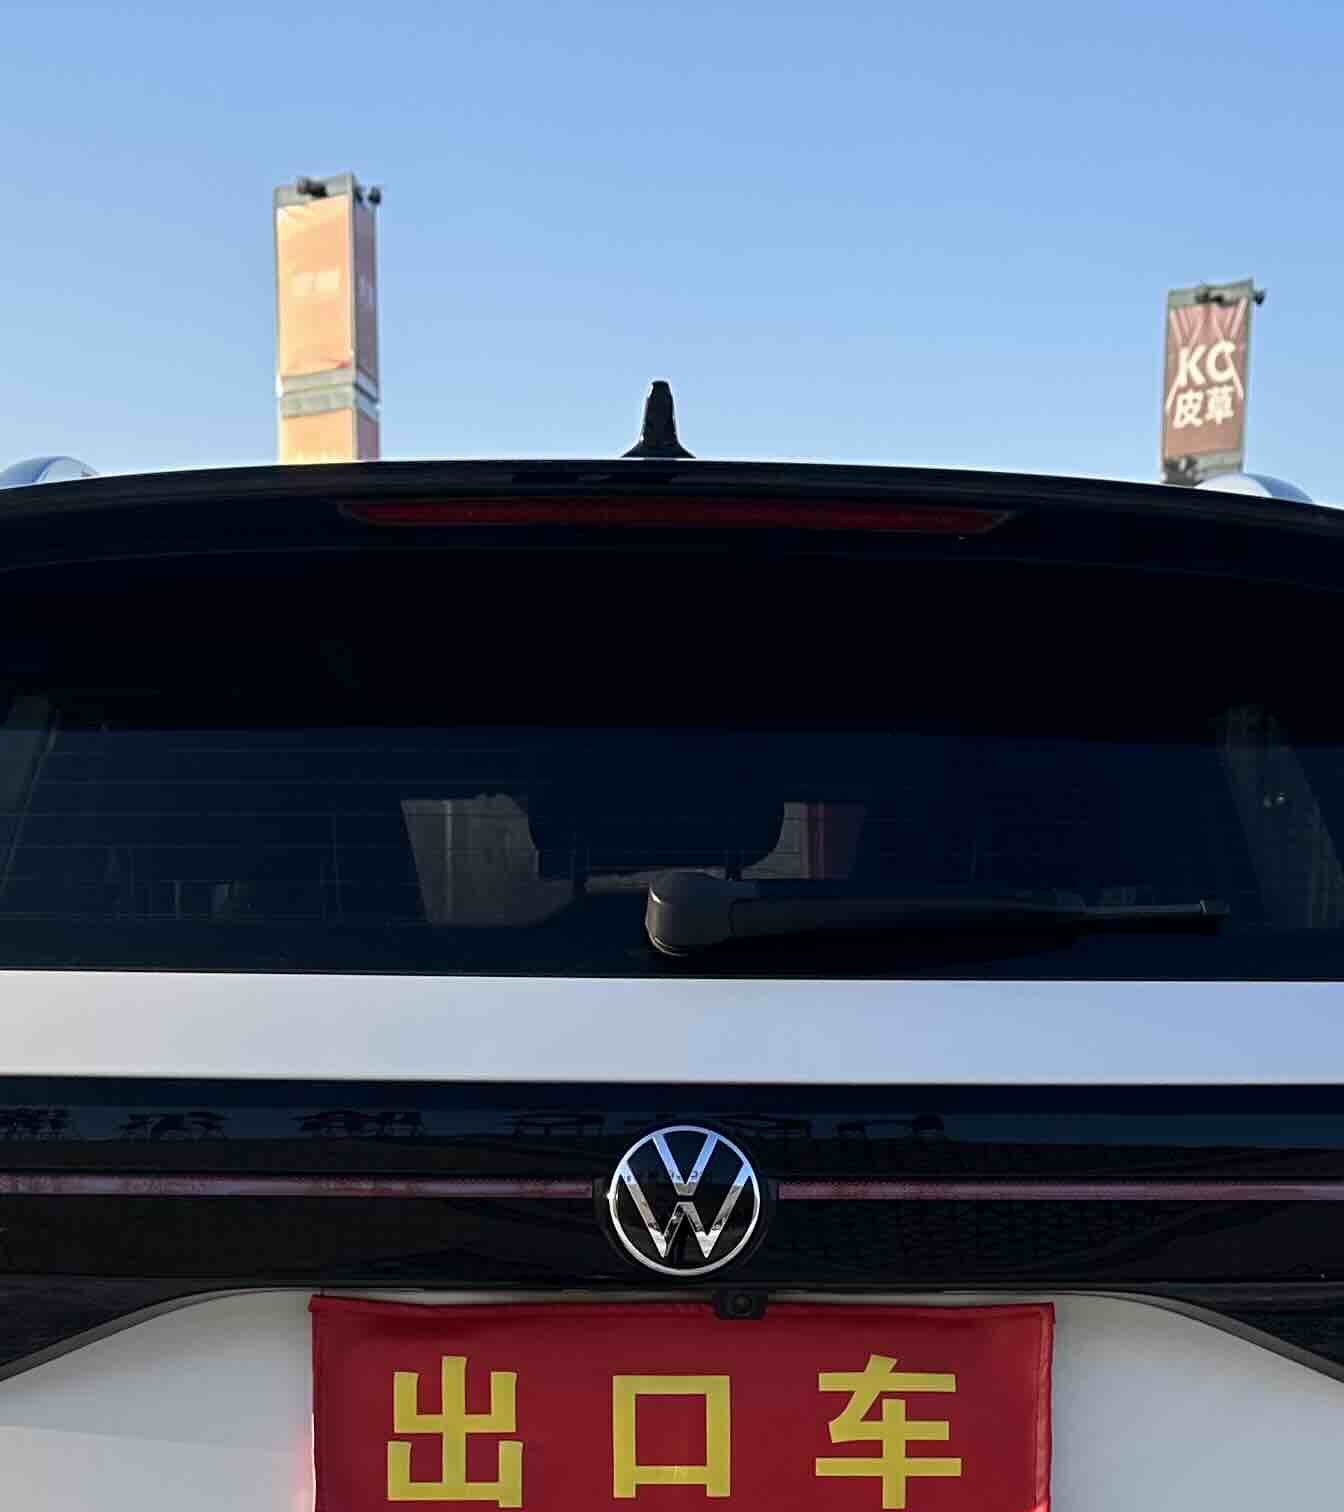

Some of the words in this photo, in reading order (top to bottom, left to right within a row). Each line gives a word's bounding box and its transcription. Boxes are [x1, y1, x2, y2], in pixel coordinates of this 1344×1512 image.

[1173, 384, 1235, 429] 皮草
[387, 1355, 962, 1510] 出口车
